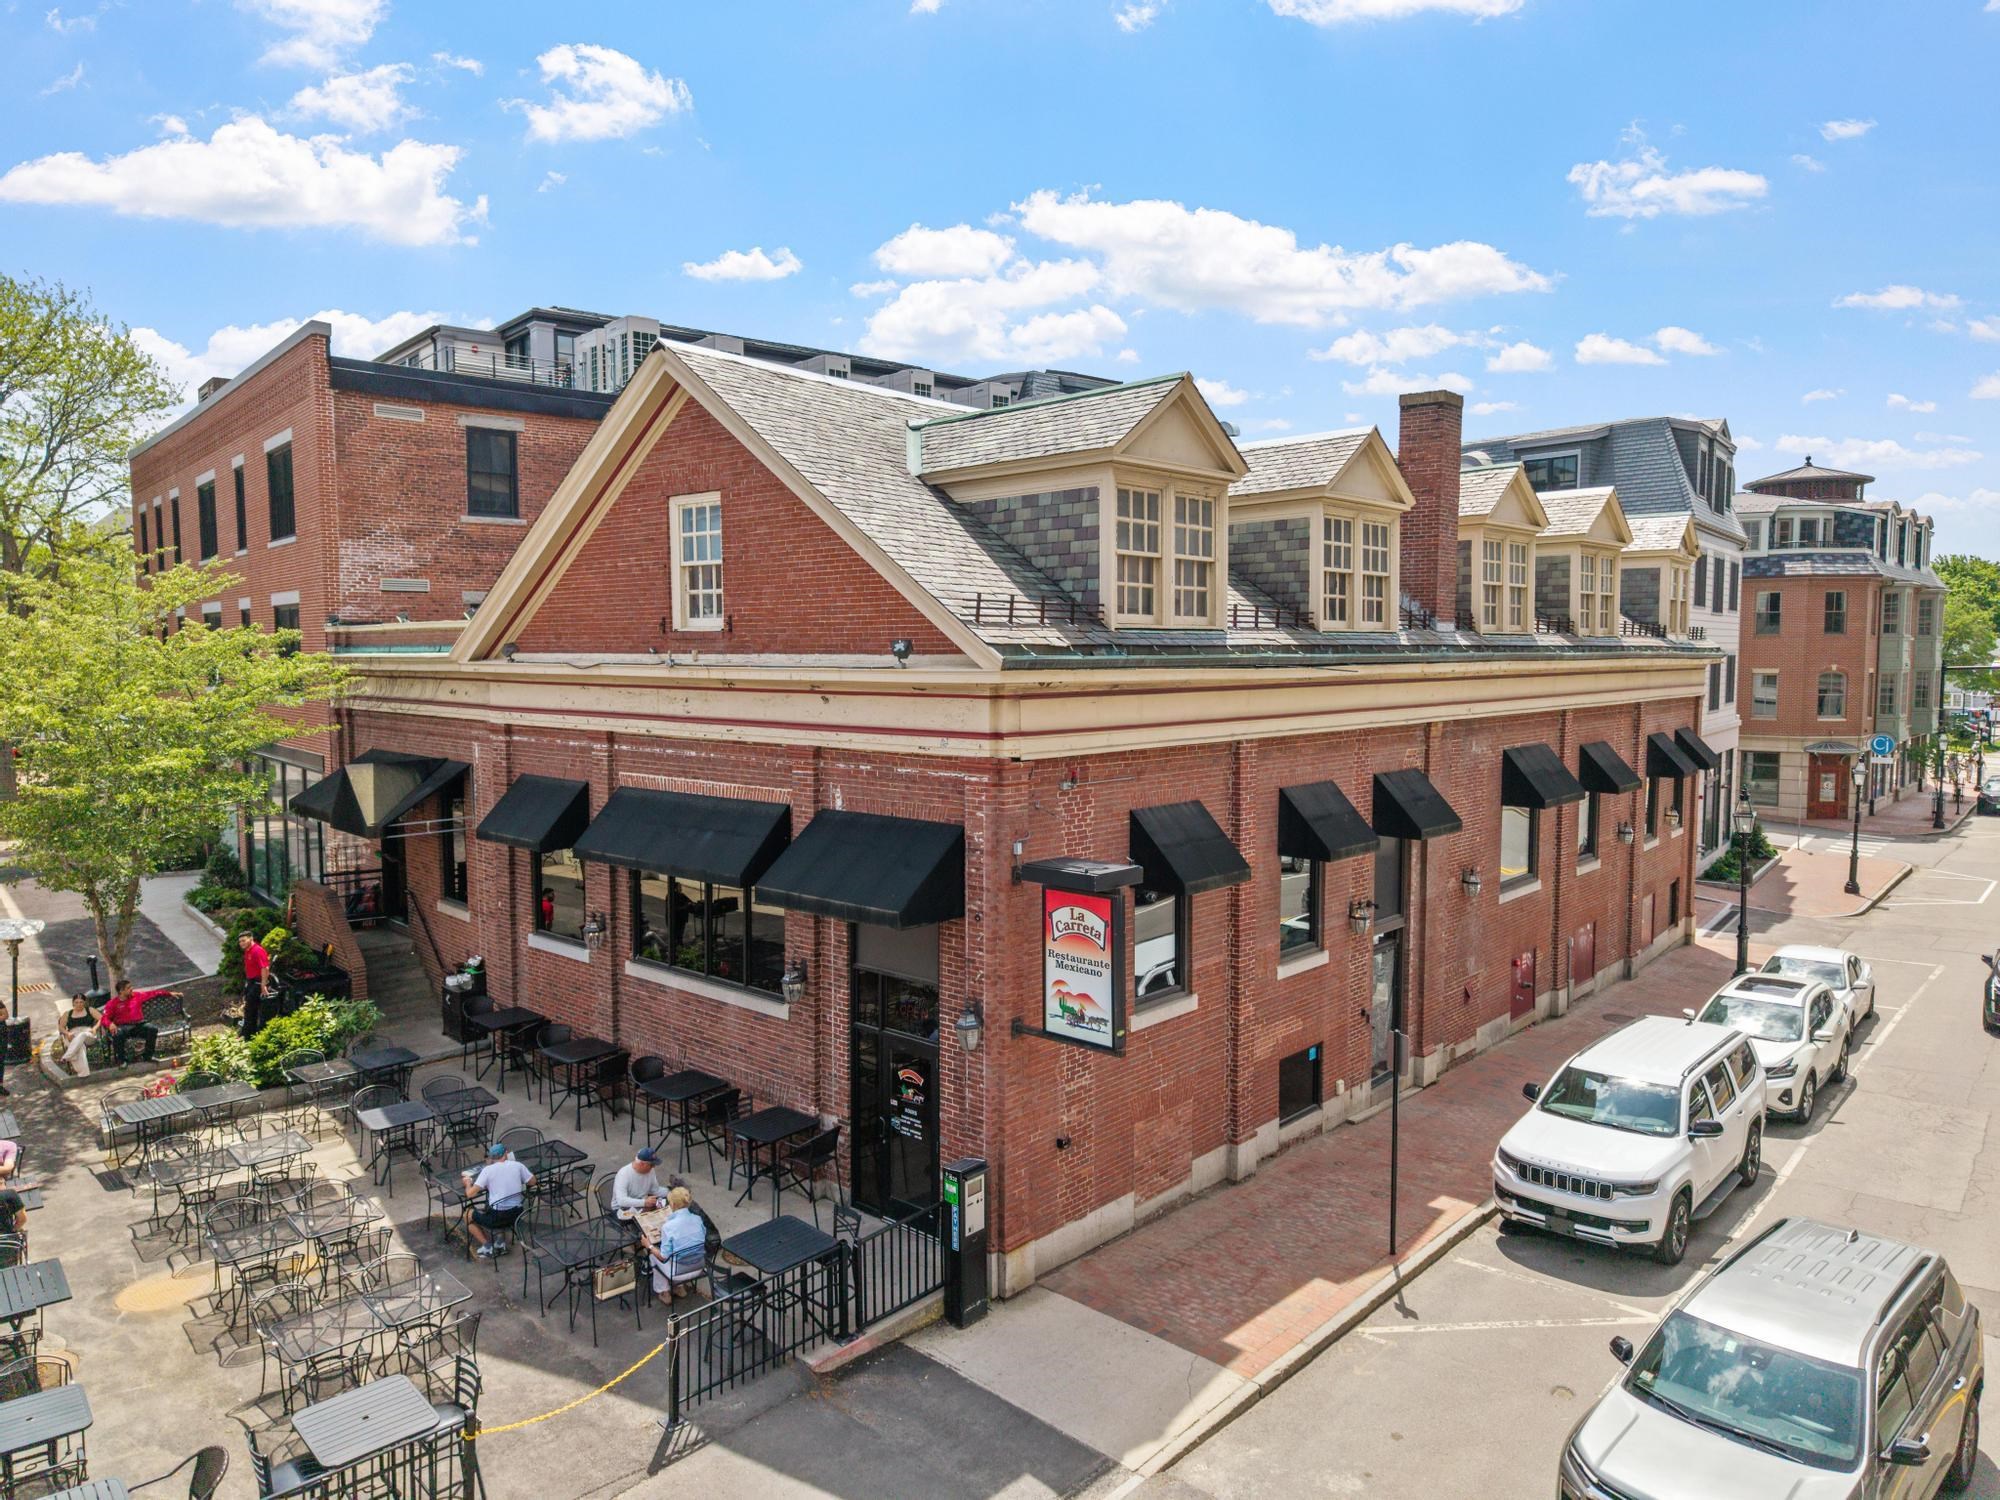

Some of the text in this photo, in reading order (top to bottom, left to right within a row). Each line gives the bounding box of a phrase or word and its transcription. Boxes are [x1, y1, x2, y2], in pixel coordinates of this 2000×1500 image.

[1069, 907, 1085, 922] La
[1055, 920, 1102, 940] Carreta
[1047, 948, 1111, 970] Restaurante
[1055, 960, 1103, 978] Mexicano
